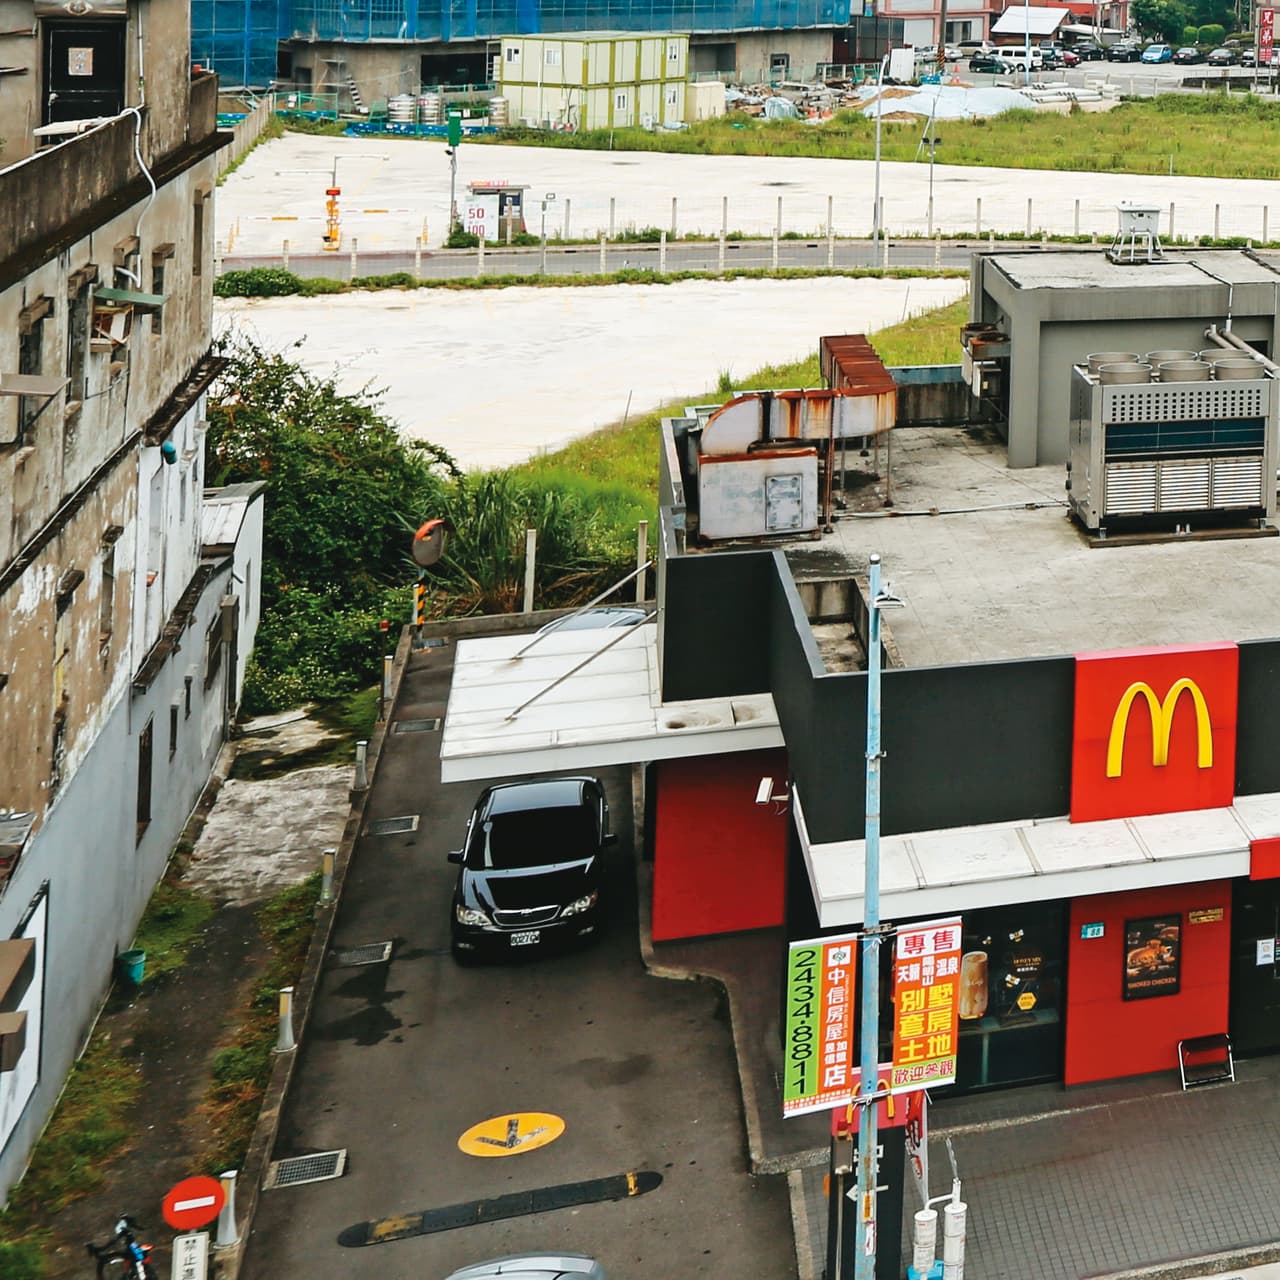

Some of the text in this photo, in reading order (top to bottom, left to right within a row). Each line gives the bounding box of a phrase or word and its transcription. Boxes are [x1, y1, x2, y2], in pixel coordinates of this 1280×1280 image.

[468, 207, 485, 219] 50
[903, 930, 954, 955] 專售
[825, 967, 846, 1042] 中信房屋
[900, 983, 953, 1013] 別墅
[899, 1007, 952, 1038] 套房
[899, 1033, 952, 1063] 土地
[823, 1064, 847, 1088] 店
